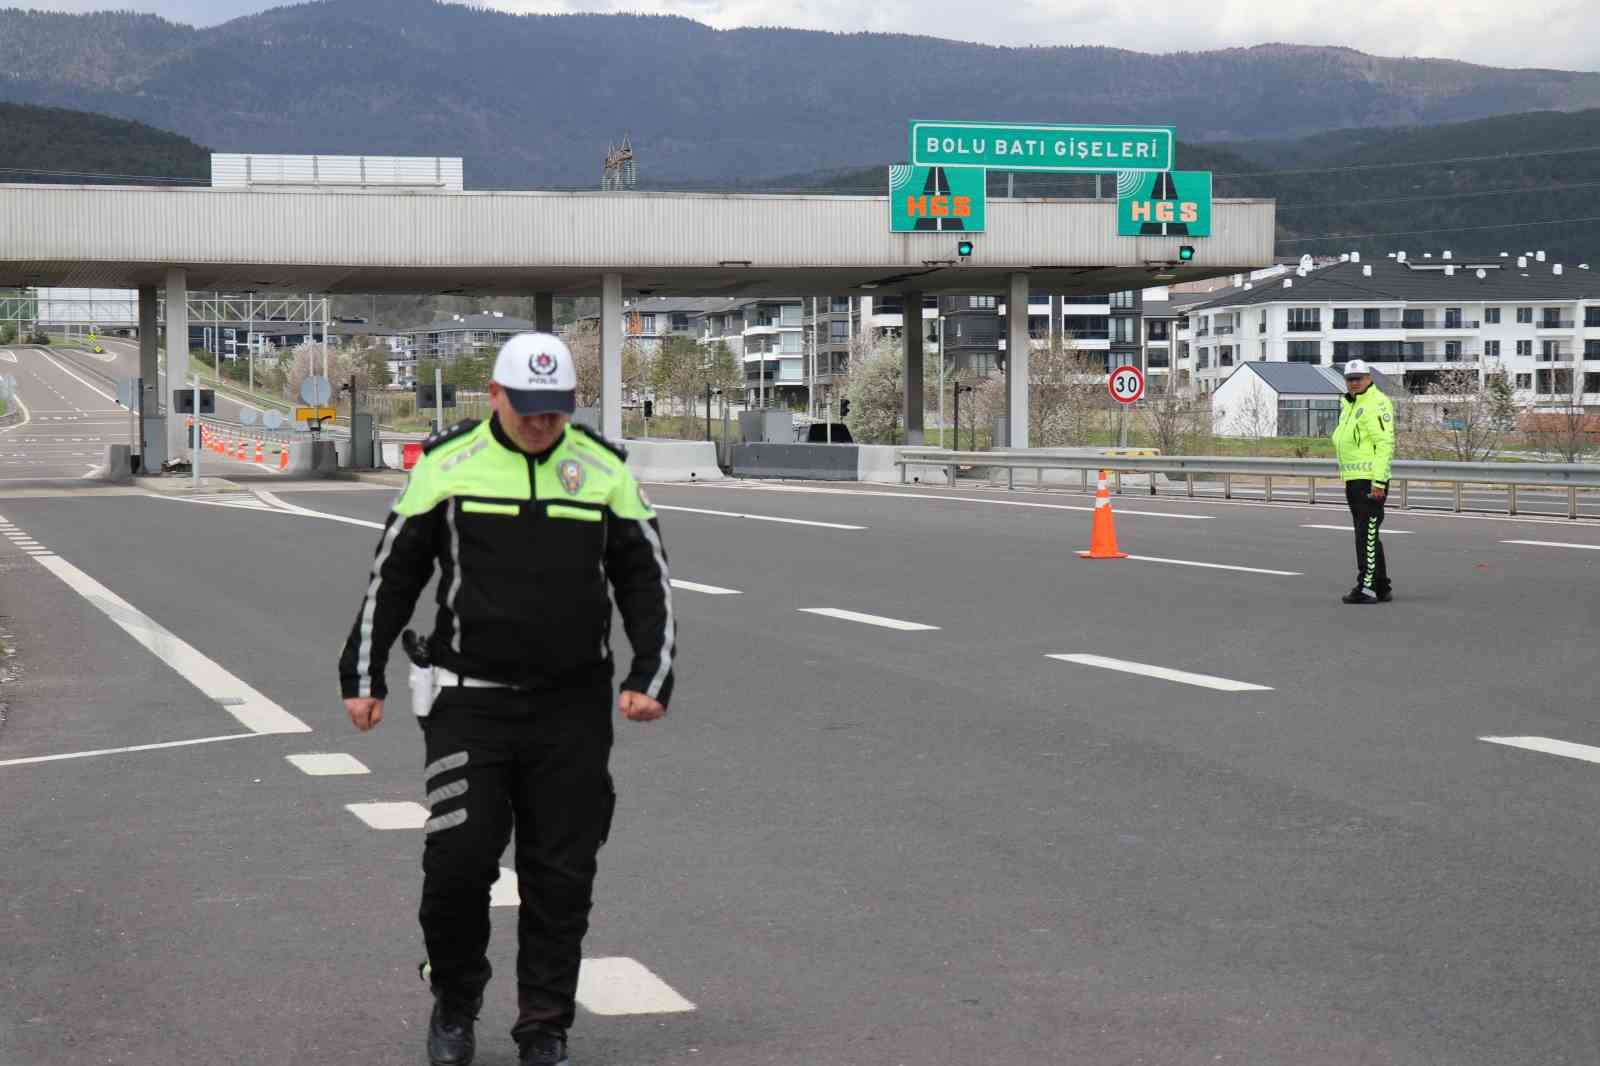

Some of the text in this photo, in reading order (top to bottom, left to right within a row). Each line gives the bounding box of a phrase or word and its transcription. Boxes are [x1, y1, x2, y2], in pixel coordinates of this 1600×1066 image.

[927, 137, 1157, 159] BOLU BATI GİŞELERİ
[907, 195, 971, 217] HGS
[1131, 200, 1198, 222] HGS
[1116, 376, 1137, 393] 30
